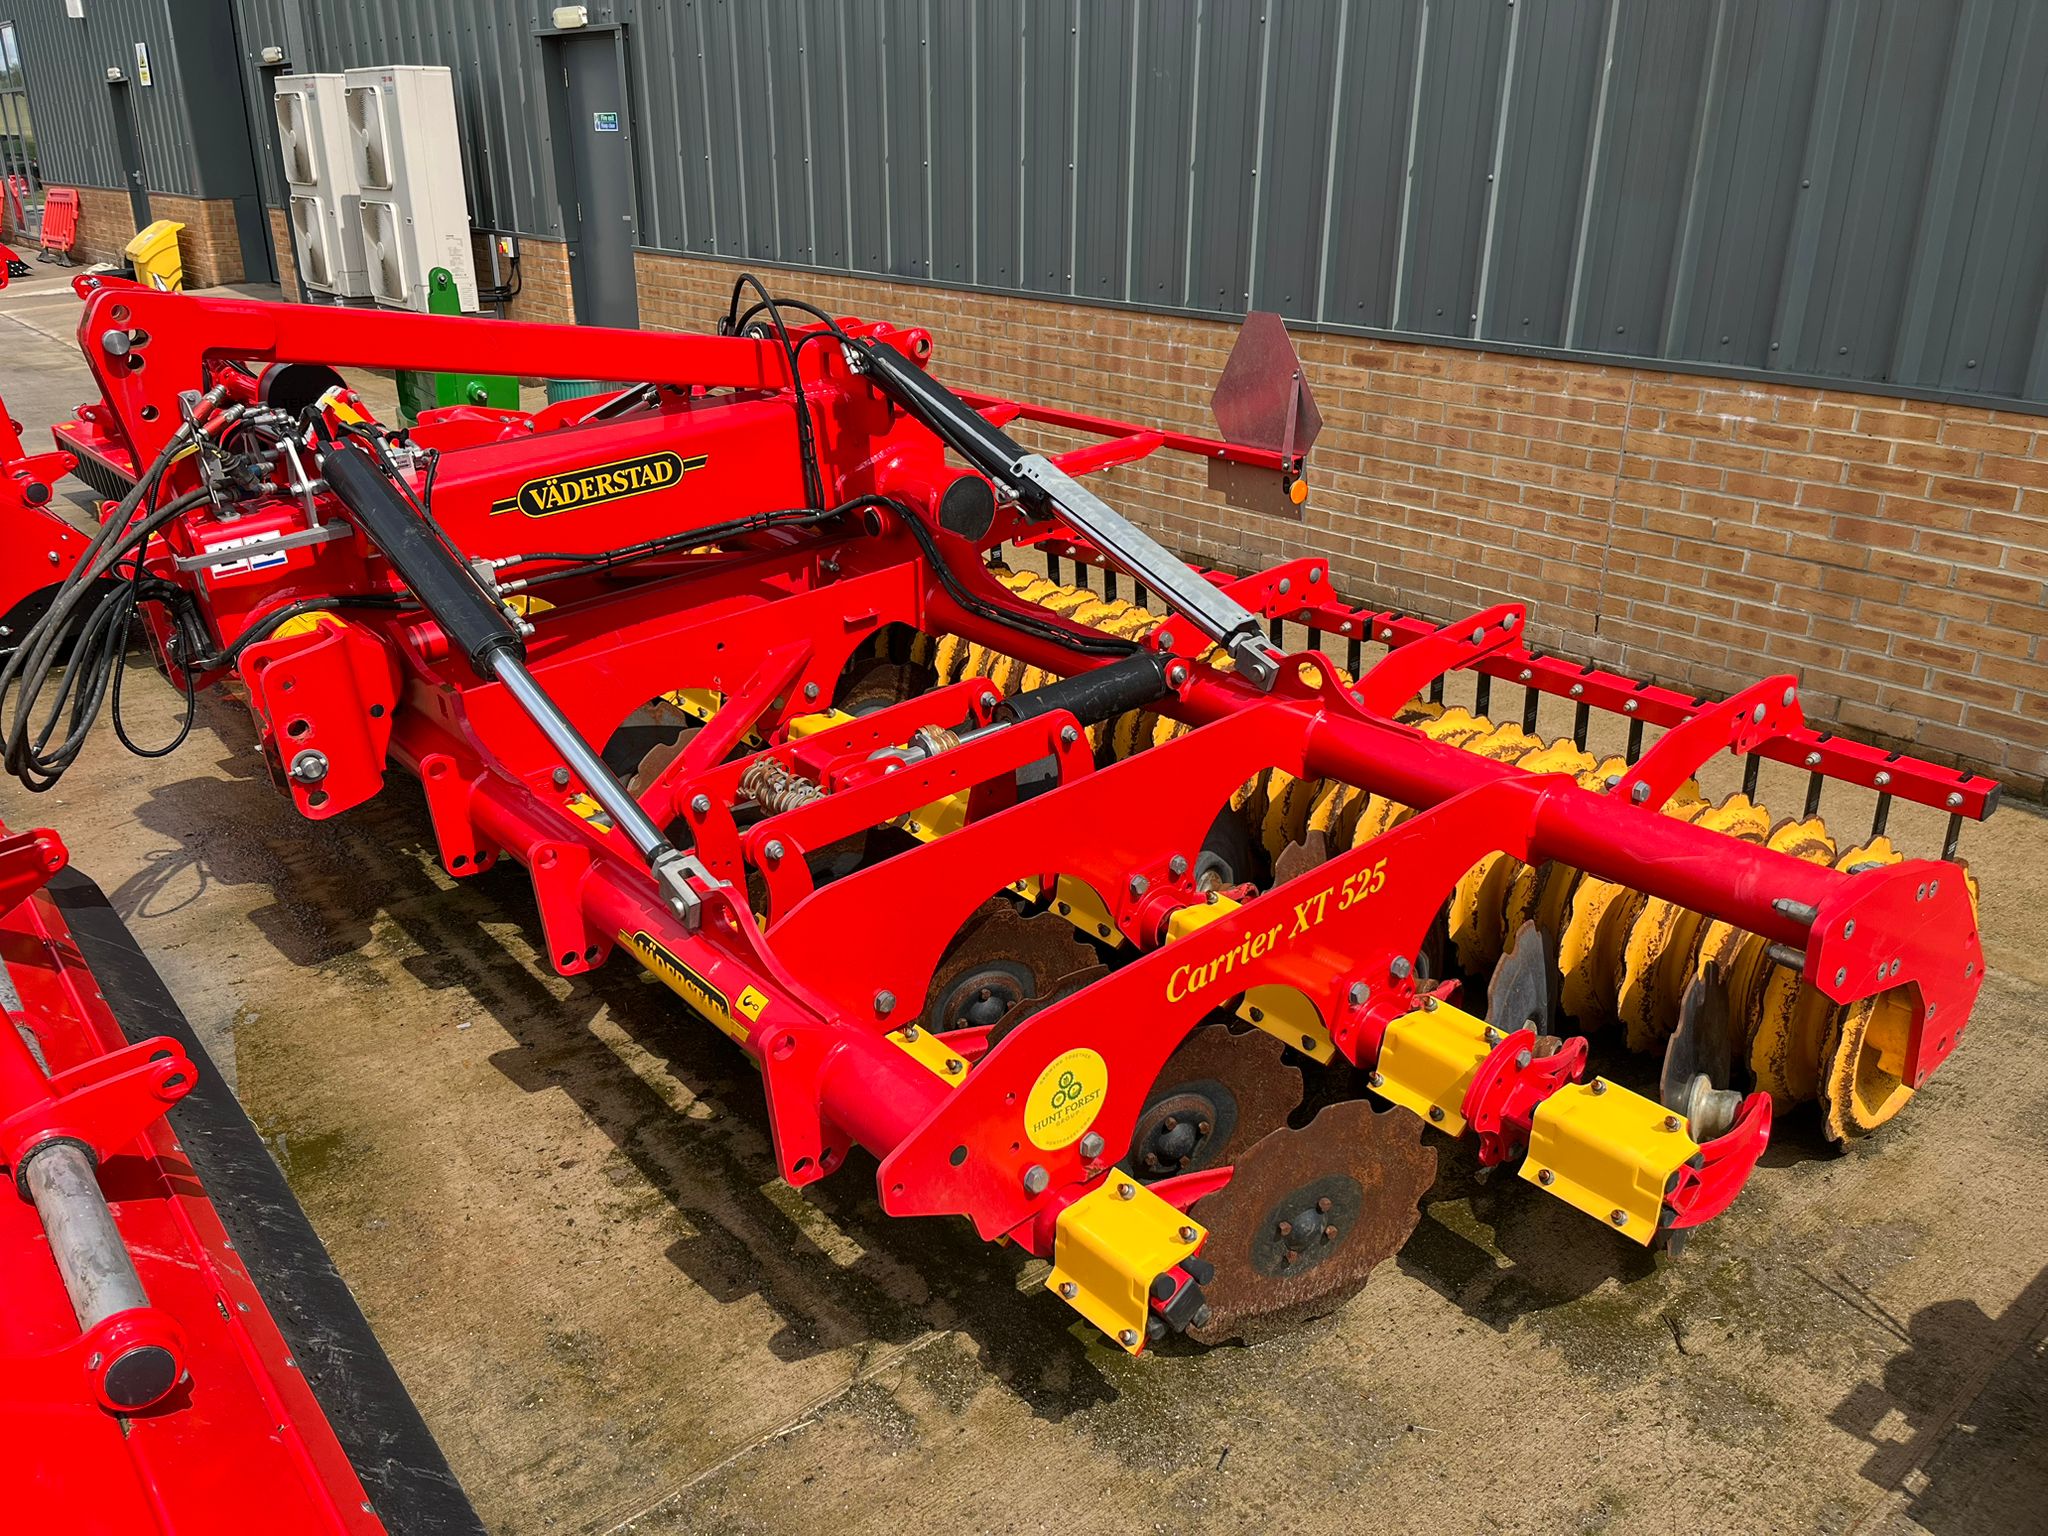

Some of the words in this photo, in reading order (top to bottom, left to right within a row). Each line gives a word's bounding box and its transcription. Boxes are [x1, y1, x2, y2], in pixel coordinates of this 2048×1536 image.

[529, 458, 673, 510] VÄDERSTAD
[1166, 923, 1283, 1003] Carrier
[1288, 885, 1334, 940] XT
[1338, 857, 1388, 911] 525
[1033, 1110, 1063, 1133] HUNT
[1065, 1089, 1101, 1114] FOREST
[1056, 1110, 1080, 1127] GROUP
